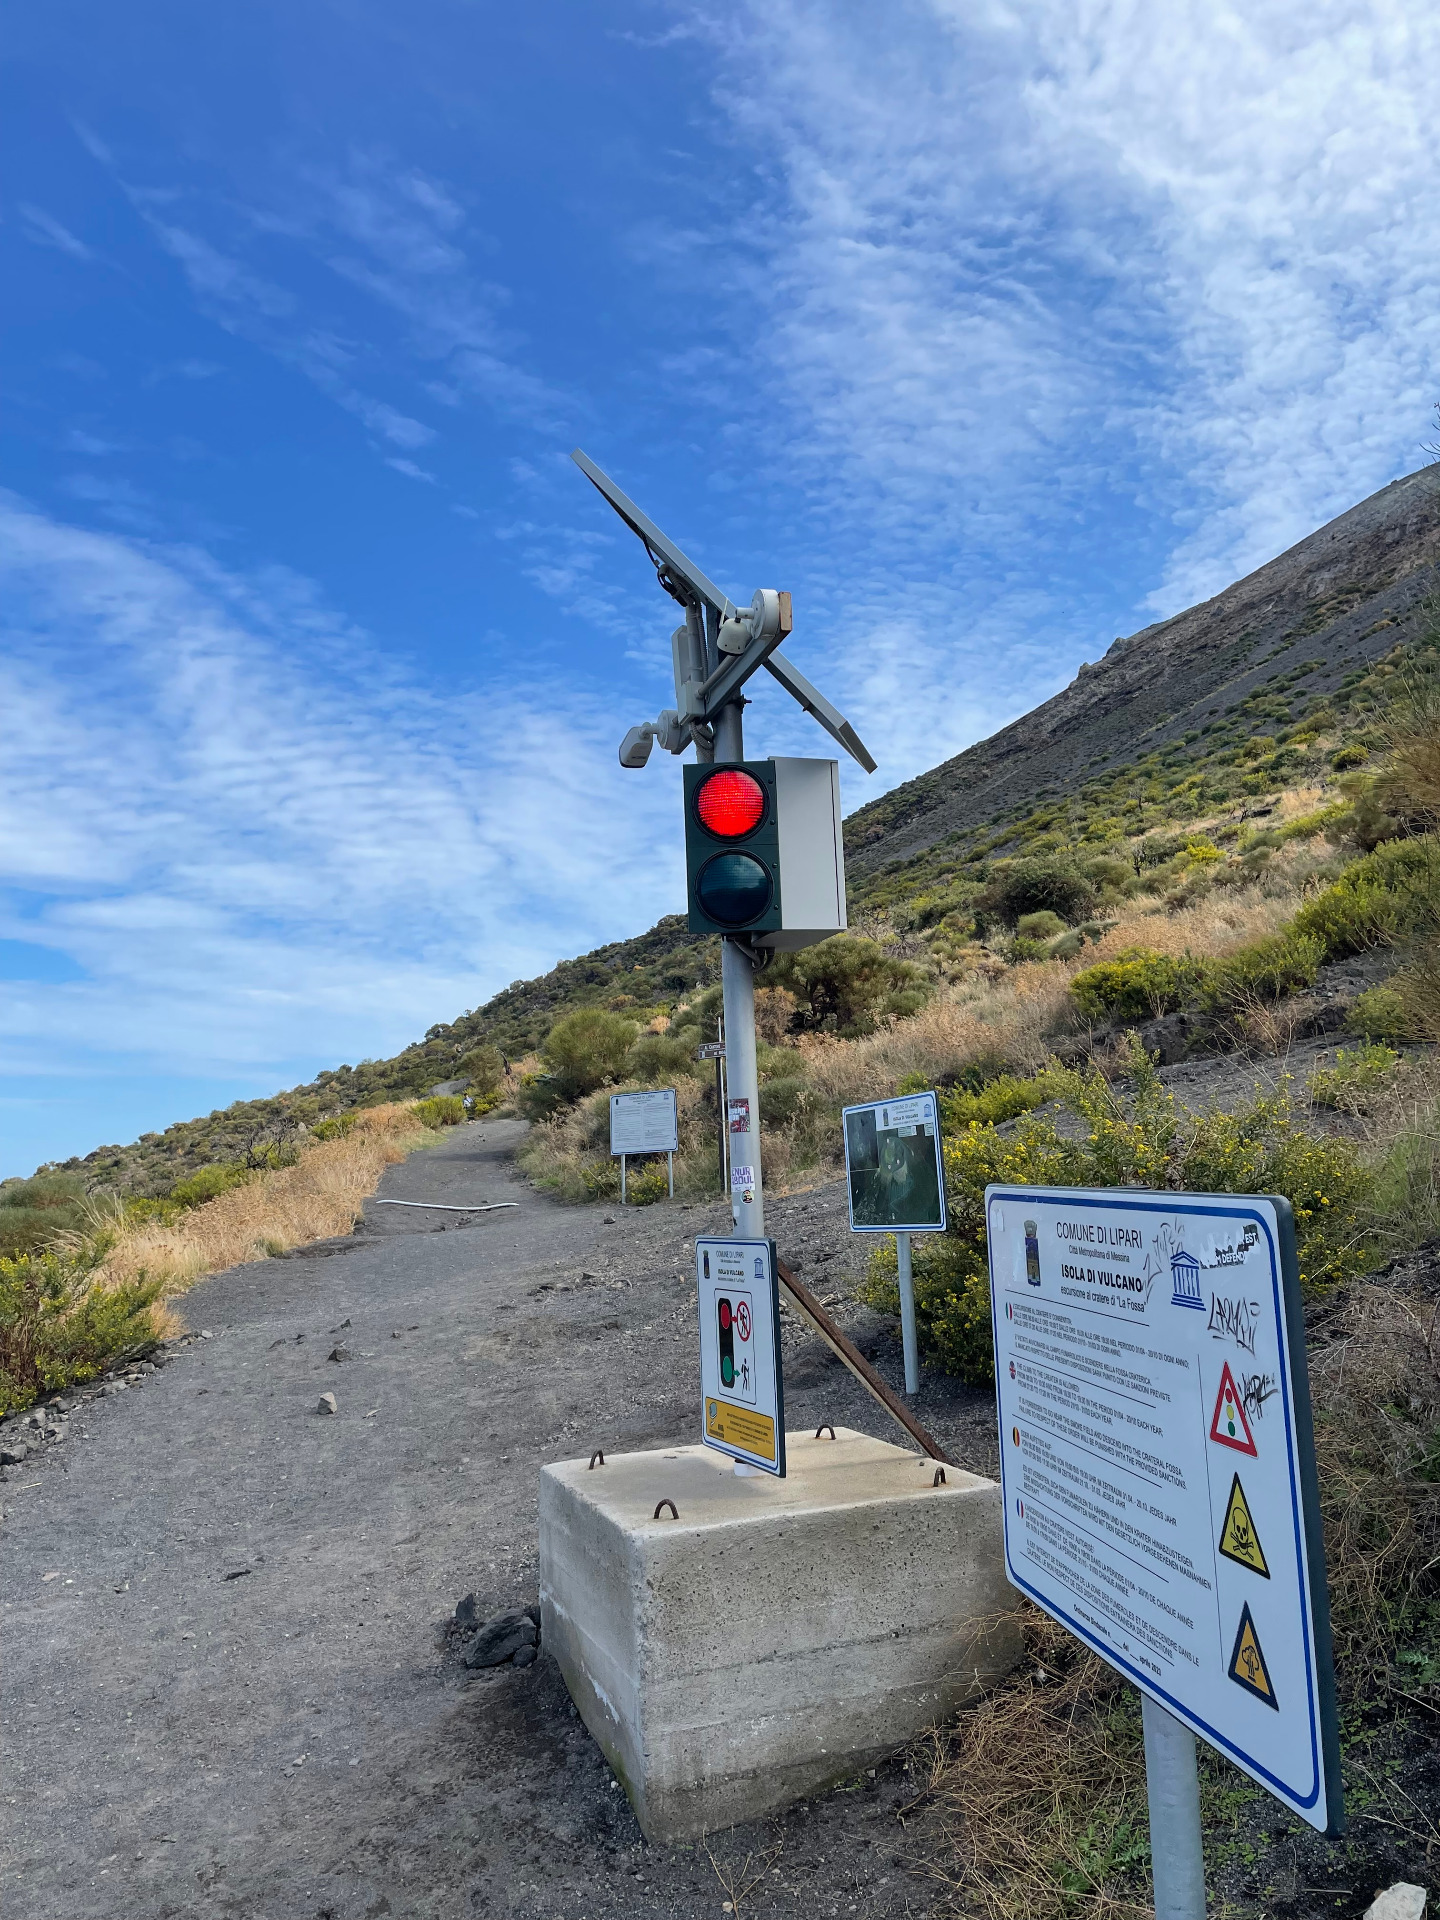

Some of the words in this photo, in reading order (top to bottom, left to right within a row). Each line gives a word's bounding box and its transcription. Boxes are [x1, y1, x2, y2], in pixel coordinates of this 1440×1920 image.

[1056, 1222, 1095, 1242] COMUNE
[1097, 1226, 1107, 1244] DI
[1109, 1228, 1143, 1249] LIPARI
[1069, 1245, 1078, 1255] Città
[1079, 1246, 1105, 1260] Metropolitana
[1106, 1250, 1110, 1260] di
[1111, 1251, 1130, 1263] Messina
[1061, 1264, 1085, 1282] ISOLA
[1087, 1269, 1095, 1284] DI
[1098, 1271, 1142, 1293] VULCANO
[1061, 1284, 1085, 1299] escursione
[1086, 1290, 1091, 1300] al
[1092, 1291, 1109, 1305] cratere
[1110, 1294, 1116, 1306] di
[1116, 1296, 1126, 1309] "La
[1127, 1298, 1147, 1314] Fossa"
